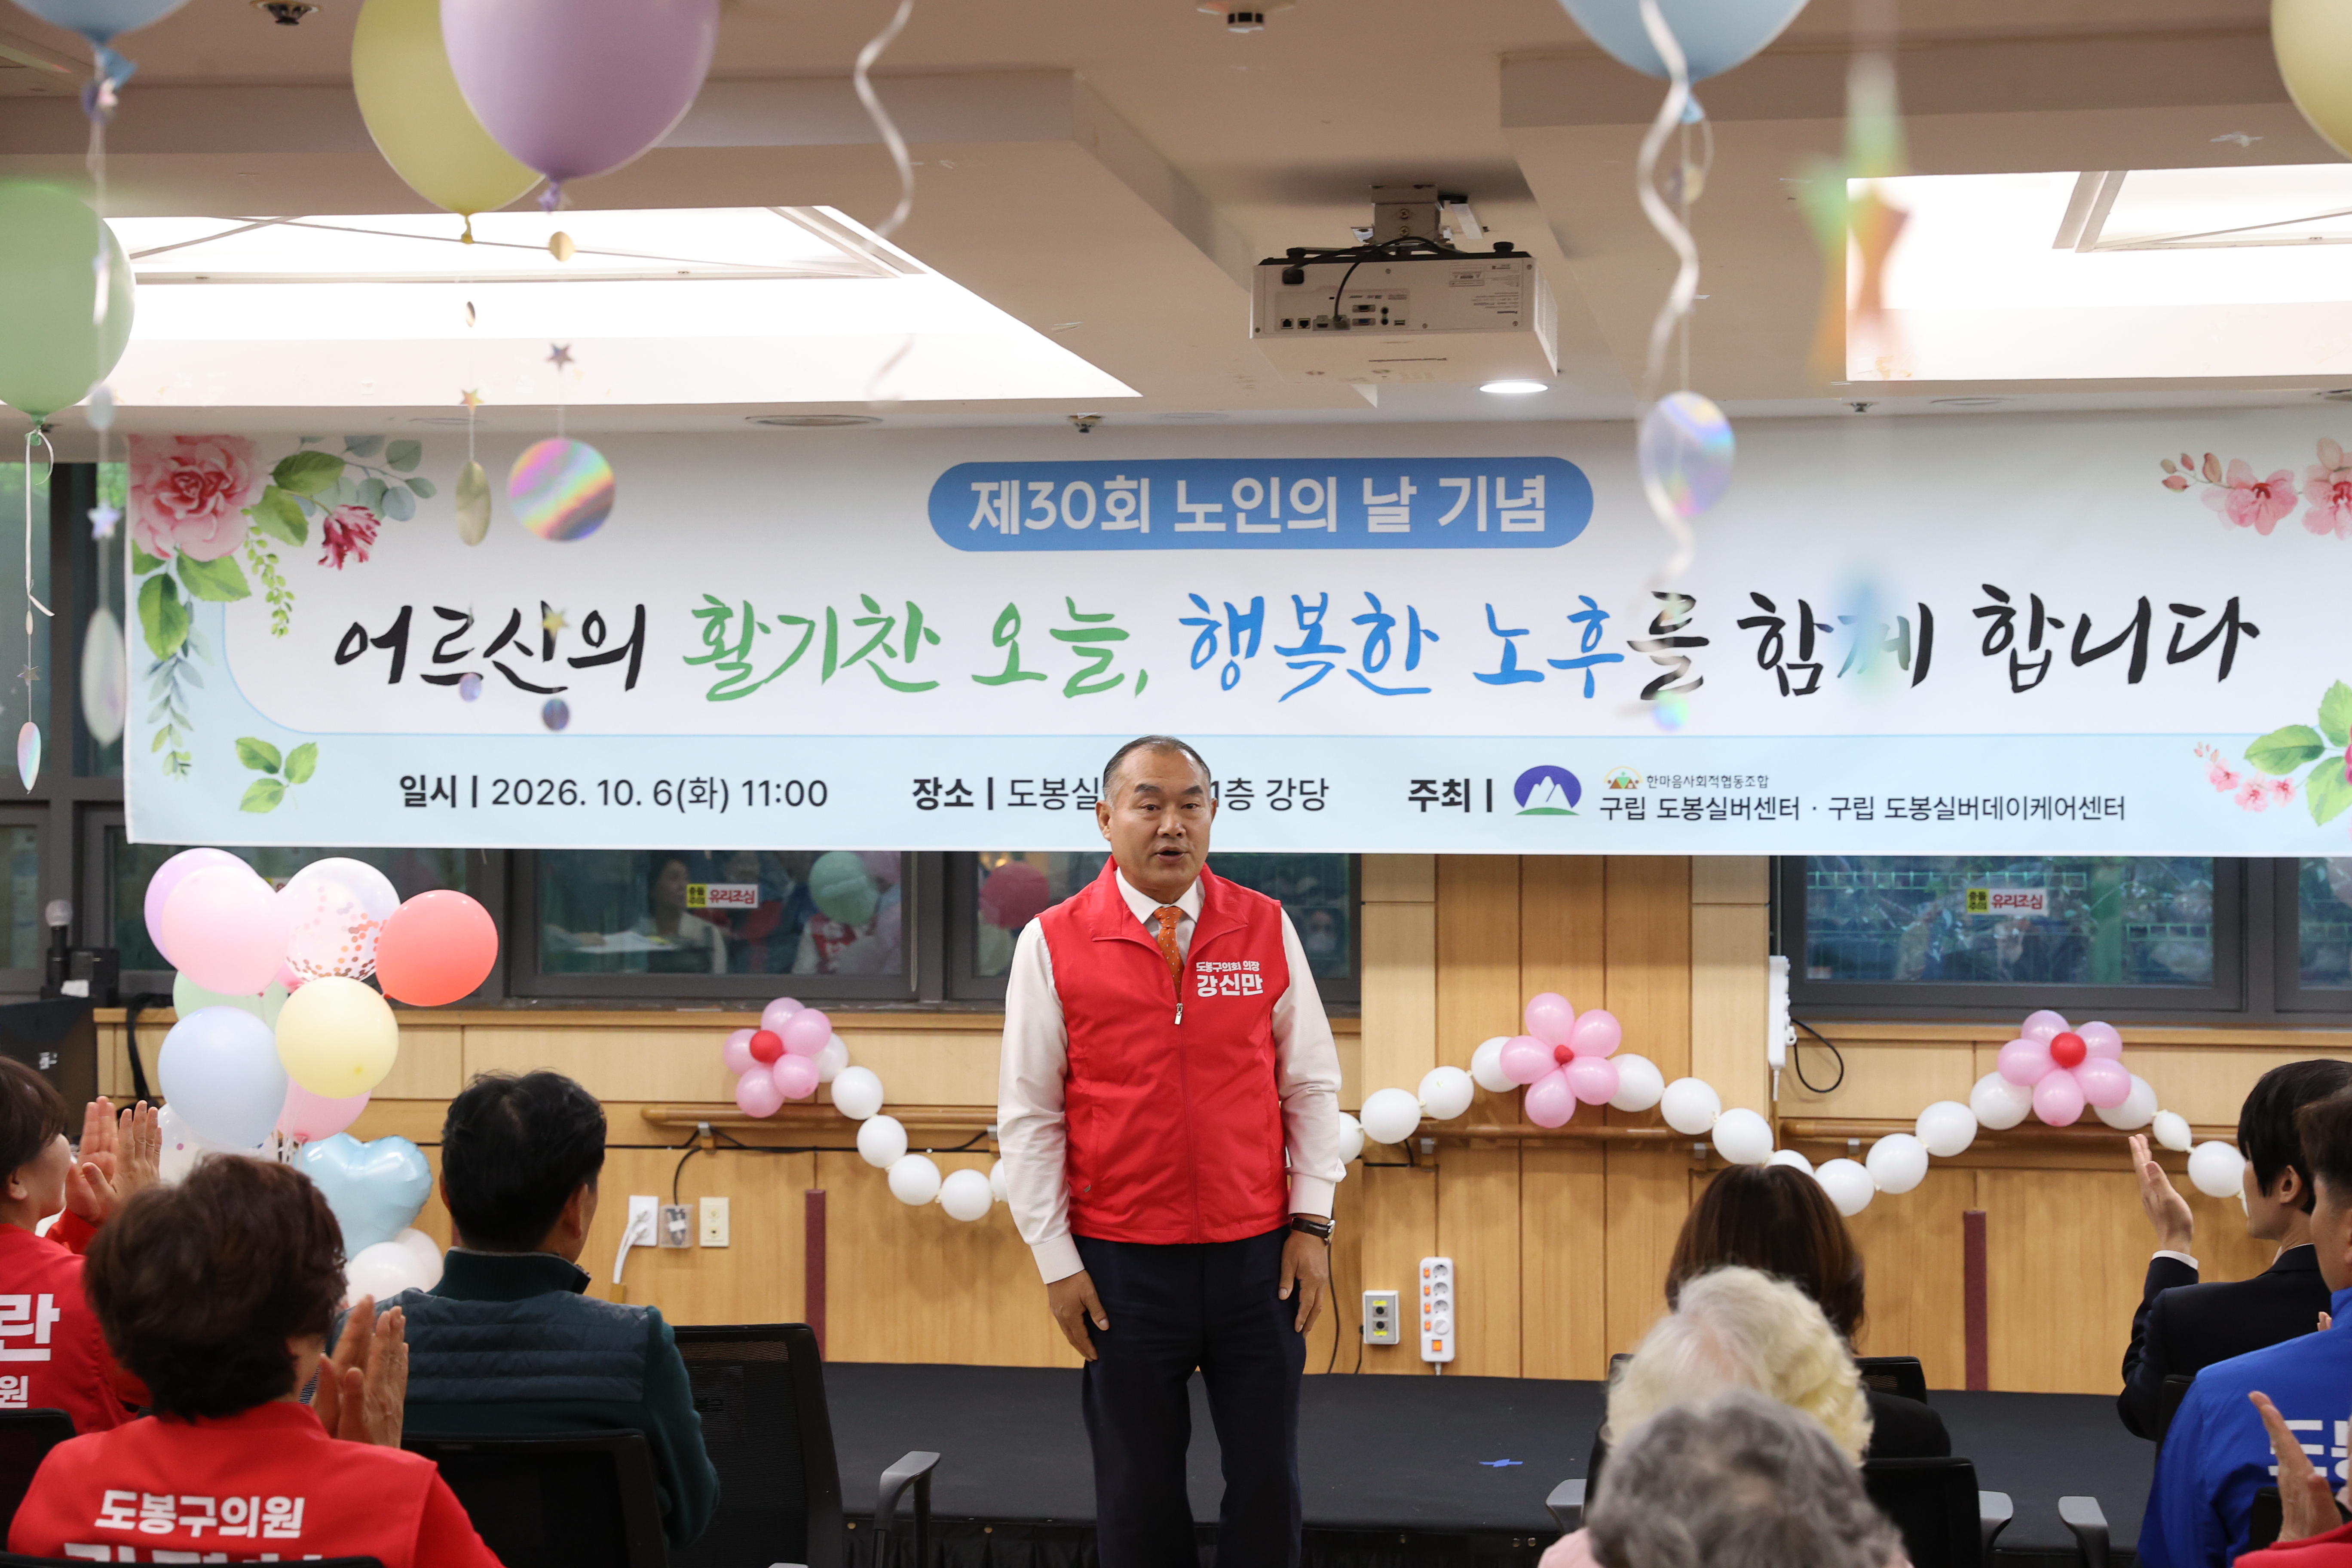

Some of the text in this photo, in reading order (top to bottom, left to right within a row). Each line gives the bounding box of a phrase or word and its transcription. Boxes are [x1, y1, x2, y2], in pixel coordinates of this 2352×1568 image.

[969, 476, 1544, 534] 제30회 노인의 날 기념
[335, 601, 645, 694] 어르신의
[684, 595, 940, 701] 활기찬
[974, 598, 1147, 698] 오늘,
[1179, 592, 1439, 702] 행복한
[1474, 591, 1709, 700] 노후를
[1973, 584, 2259, 693] 합니다
[400, 775, 456, 808] 일시
[492, 779, 585, 805] 2026.
[654, 777, 729, 813] 6(화)
[743, 780, 827, 806] 11:00
[913, 777, 974, 810] 장소
[1008, 778, 1099, 810] 도봉실
[1267, 778, 1329, 811] 강당
[1409, 778, 1470, 812] 주최
[1647, 775, 1768, 789] 한마음사회적협동조합
[1600, 796, 2124, 821] 구립 도봉실버센터 구립 도봉실버데이케어센터
[709, 889, 755, 904] 유리조심
[1992, 894, 2043, 910] 유리조심
[1197, 961, 1259, 972] 도봉구의회 의장
[1197, 973, 1264, 997] 강신만
[95, 1490, 304, 1538] 도봉구의원
